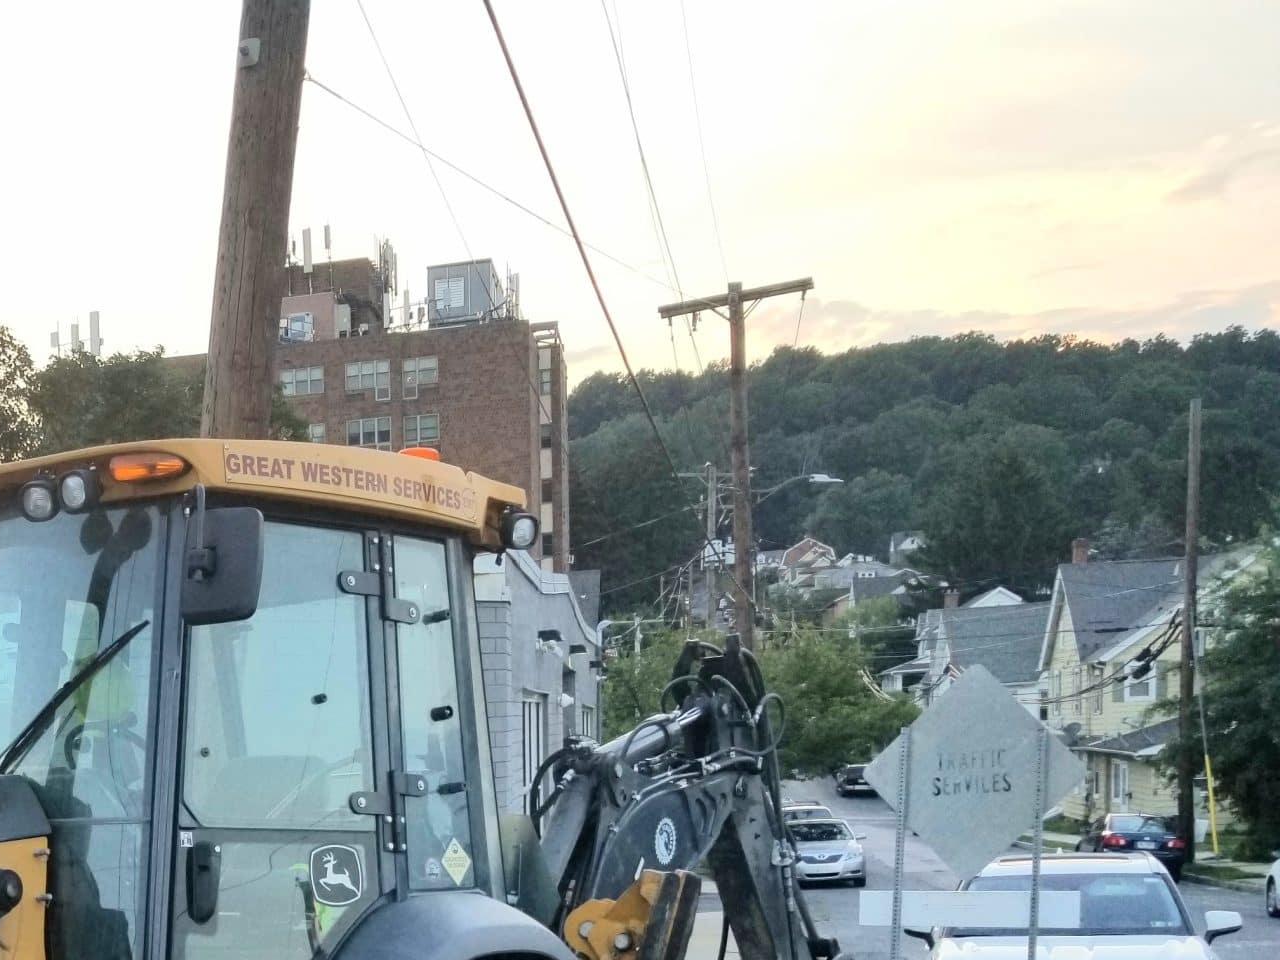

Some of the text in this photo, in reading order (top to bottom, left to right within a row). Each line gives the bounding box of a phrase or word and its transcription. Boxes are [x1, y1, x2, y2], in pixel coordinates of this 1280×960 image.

[226, 453, 295, 480] GREAT
[301, 461, 388, 493] WESTERN
[393, 476, 461, 510] SERVICES
[932, 773, 1012, 797] SERVICES
